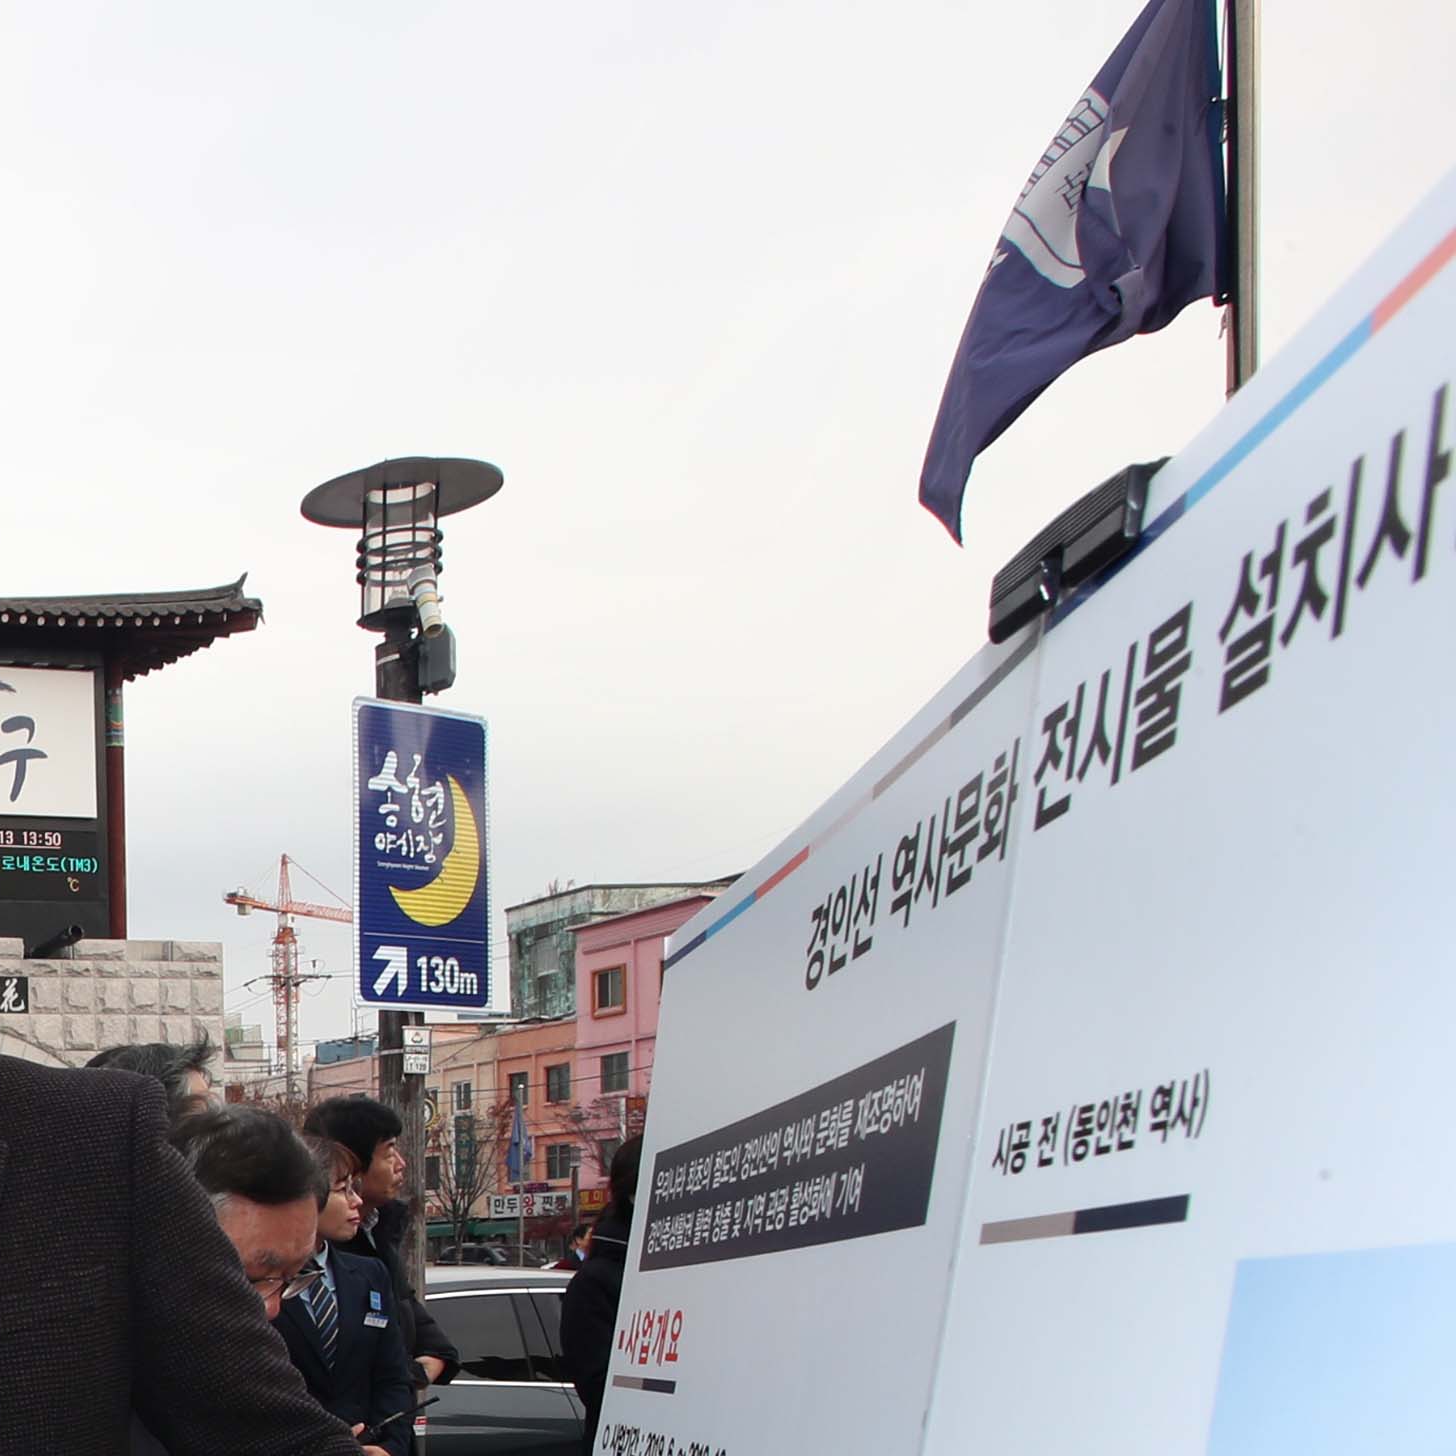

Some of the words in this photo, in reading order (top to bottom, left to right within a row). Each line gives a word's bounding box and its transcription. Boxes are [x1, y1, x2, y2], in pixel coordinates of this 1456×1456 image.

[805, 853, 883, 992] 경인선
[890, 737, 1021, 929] 역사문화
[1034, 600, 1195, 833] 전시물
[1218, 380, 1456, 715] 설치사
[367, 750, 447, 828] 송현
[0, 854, 99, 874] 로내온도(TM3)
[22, 830, 62, 847] 13:50
[374, 828, 444, 864] 야시장
[416, 955, 479, 996] 130m
[654, 1160, 687, 1204] 우리나라
[685, 1156, 713, 1196] 최초의
[711, 1144, 742, 1189] 철도인
[741, 1127, 782, 1181] 경인선의
[782, 1113, 816, 1168] 역사와
[815, 1098, 854, 1156] 문화를
[853, 1066, 925, 1142] 재조명하여
[991, 1119, 1033, 1177] 시공
[1036, 1110, 1061, 1169] 전
[1062, 1088, 1143, 1168] (동인천
[1148, 1067, 1211, 1145] 역사)
[493, 1197, 518, 1215] 만두
[692, 1205, 713, 1247] 활력
[711, 1202, 732, 1243] 창출
[731, 1194, 744, 1239] 및
[743, 1191, 767, 1236] 지역
[765, 1184, 790, 1232] 관광
[788, 1170, 838, 1229] 활성화에
[836, 1162, 865, 1217] 기여
[624, 1309, 684, 1366] 사업개요
